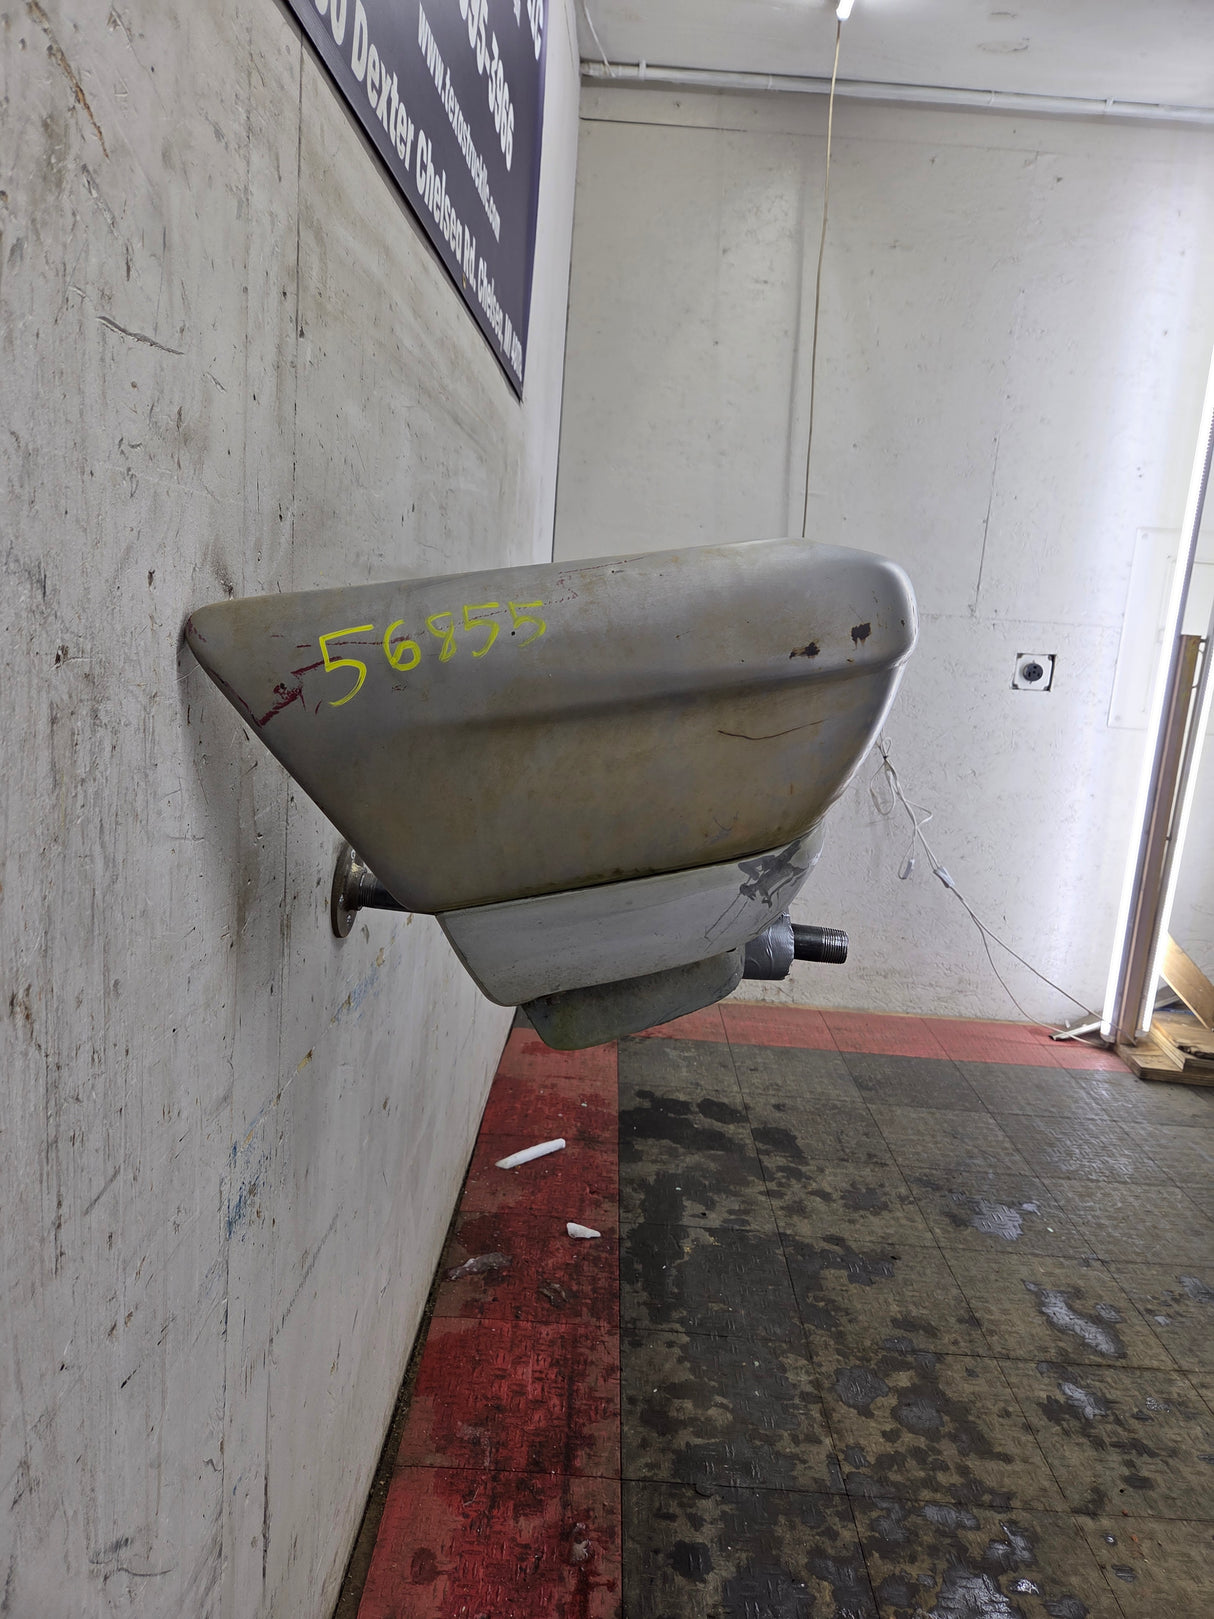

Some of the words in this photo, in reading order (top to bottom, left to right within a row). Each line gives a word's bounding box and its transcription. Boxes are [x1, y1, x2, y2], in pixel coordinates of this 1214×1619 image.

[351, 0, 415, 172] Dexter
[416, 129, 463, 264] Chelsea
[463, 224, 477, 293] Rd.
[459, 0, 515, 173] 95-3966
[318, 601, 547, 707] 56855
